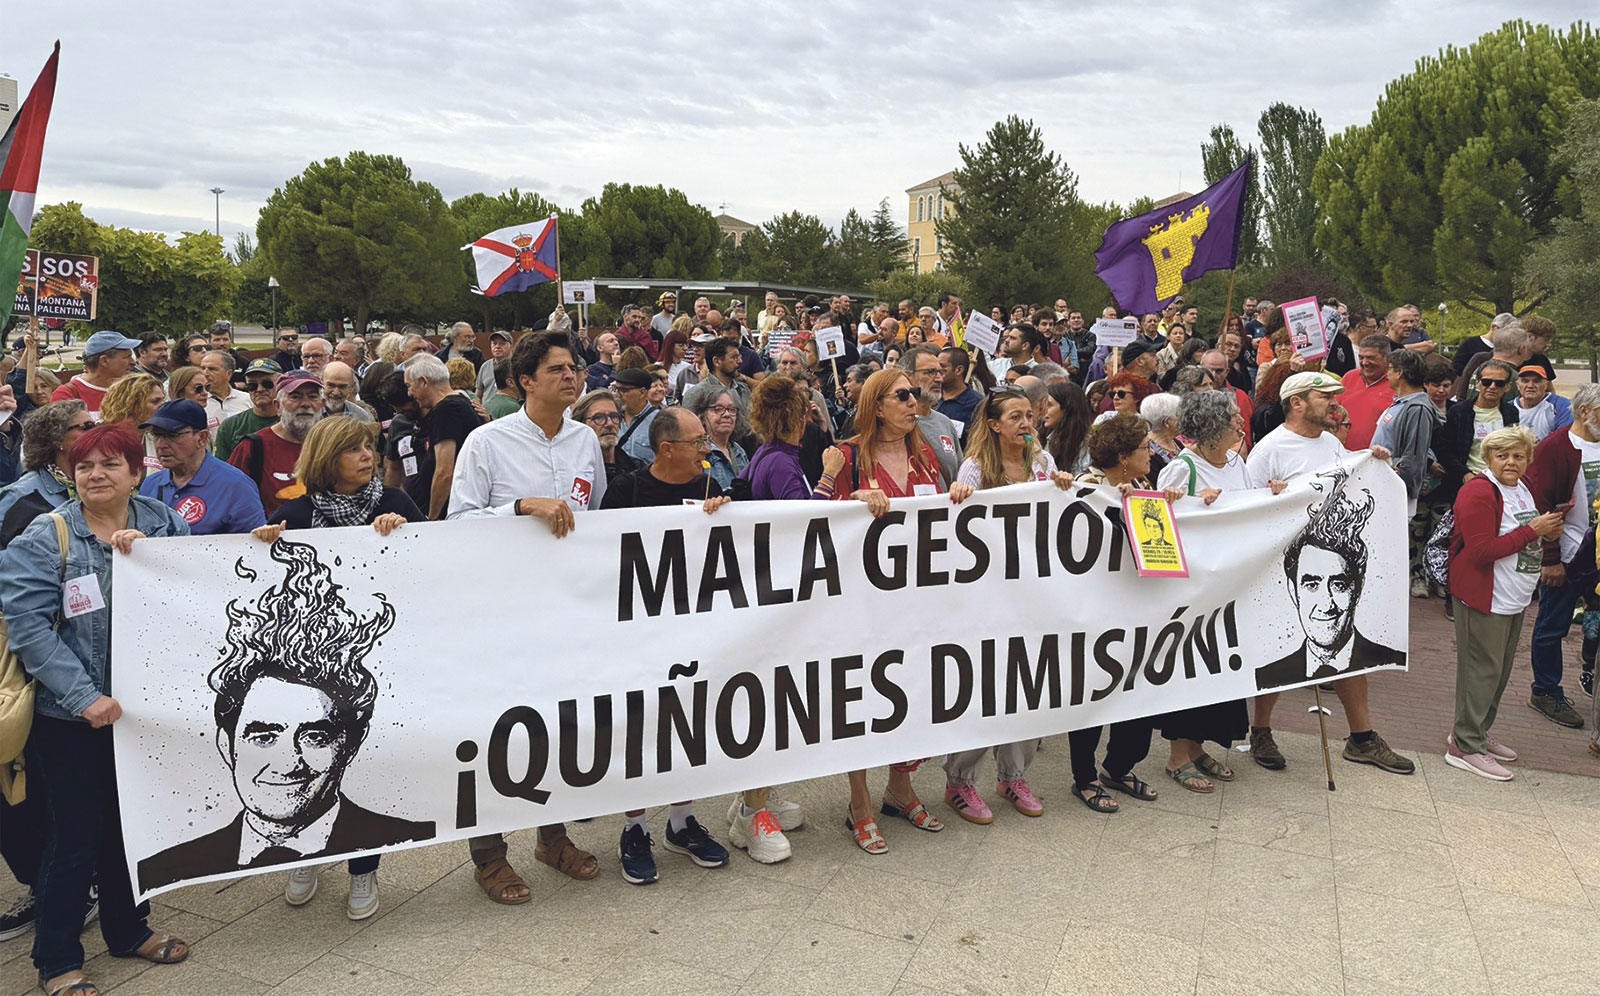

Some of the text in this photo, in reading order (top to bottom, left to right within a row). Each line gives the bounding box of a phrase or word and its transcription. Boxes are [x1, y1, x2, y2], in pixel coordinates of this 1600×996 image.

[42, 257, 89, 278] SOS
[37, 304, 88, 316] PALENTINA
[617, 517, 842, 622] MALA
[455, 599, 1243, 830] ¡QUIÑONES DIMISIÓN!
